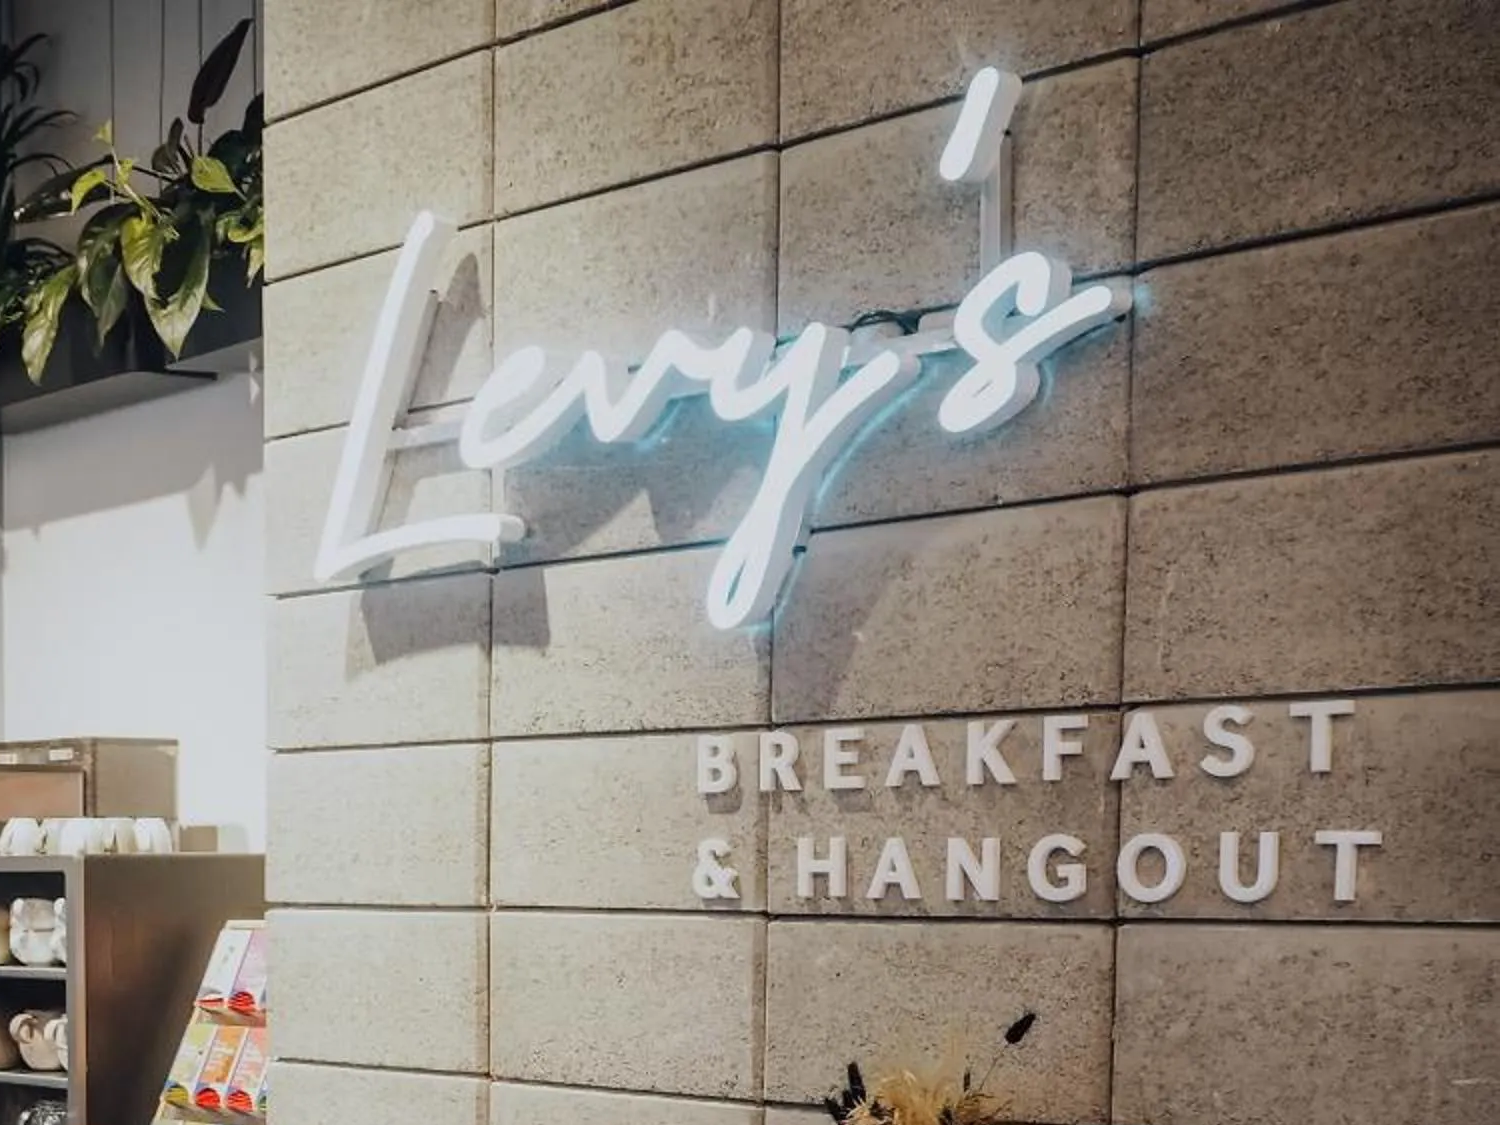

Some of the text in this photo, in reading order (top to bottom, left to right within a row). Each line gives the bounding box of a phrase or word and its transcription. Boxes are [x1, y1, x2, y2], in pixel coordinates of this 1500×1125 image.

[314, 66, 1130, 631] Levy's
[696, 699, 1356, 794] BREAKFAST
[692, 830, 1384, 902] & HANGOUT
